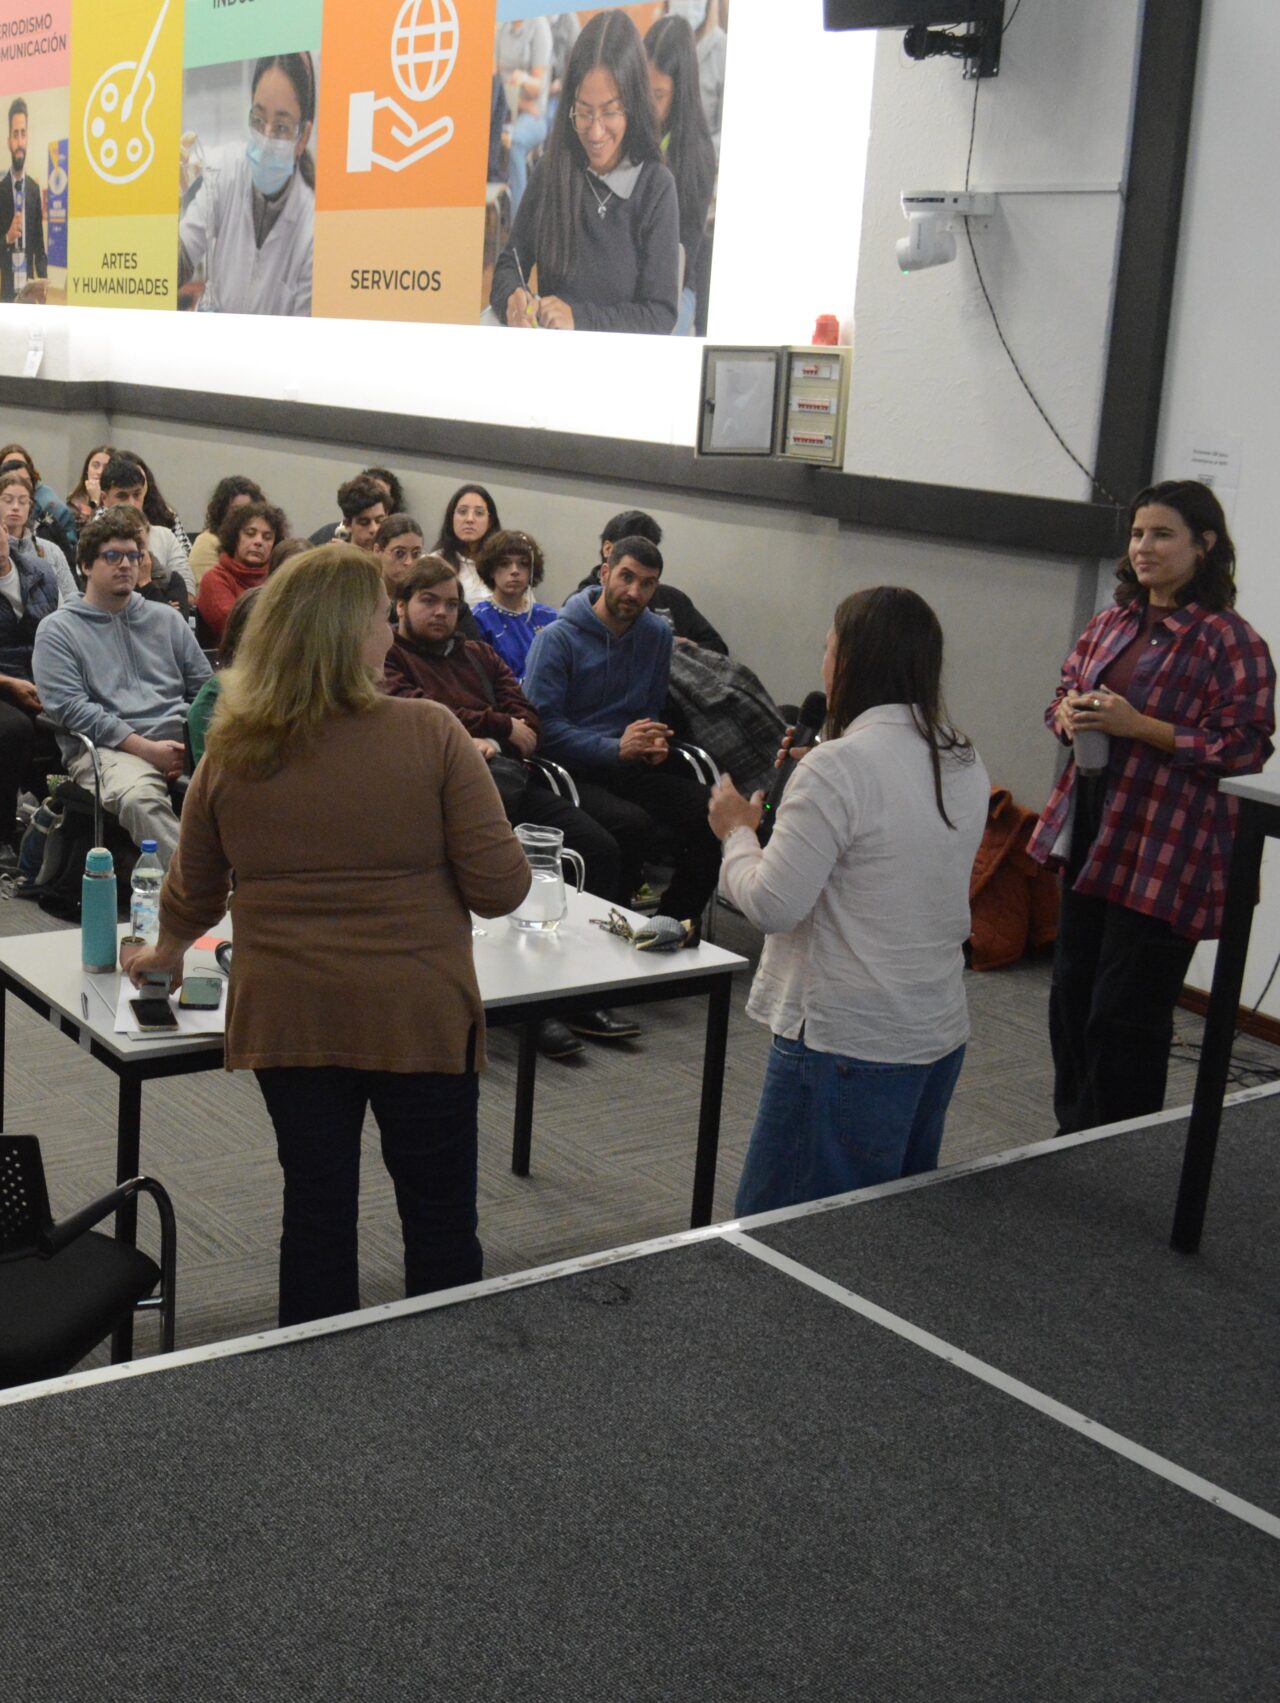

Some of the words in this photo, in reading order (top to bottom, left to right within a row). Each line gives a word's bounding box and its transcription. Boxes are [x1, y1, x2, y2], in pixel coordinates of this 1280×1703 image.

[101, 252, 138, 270] ARTES
[73, 277, 80, 294] Y
[82, 277, 169, 297] HUMANIDADES
[350, 269, 441, 292] SERVICIOS
